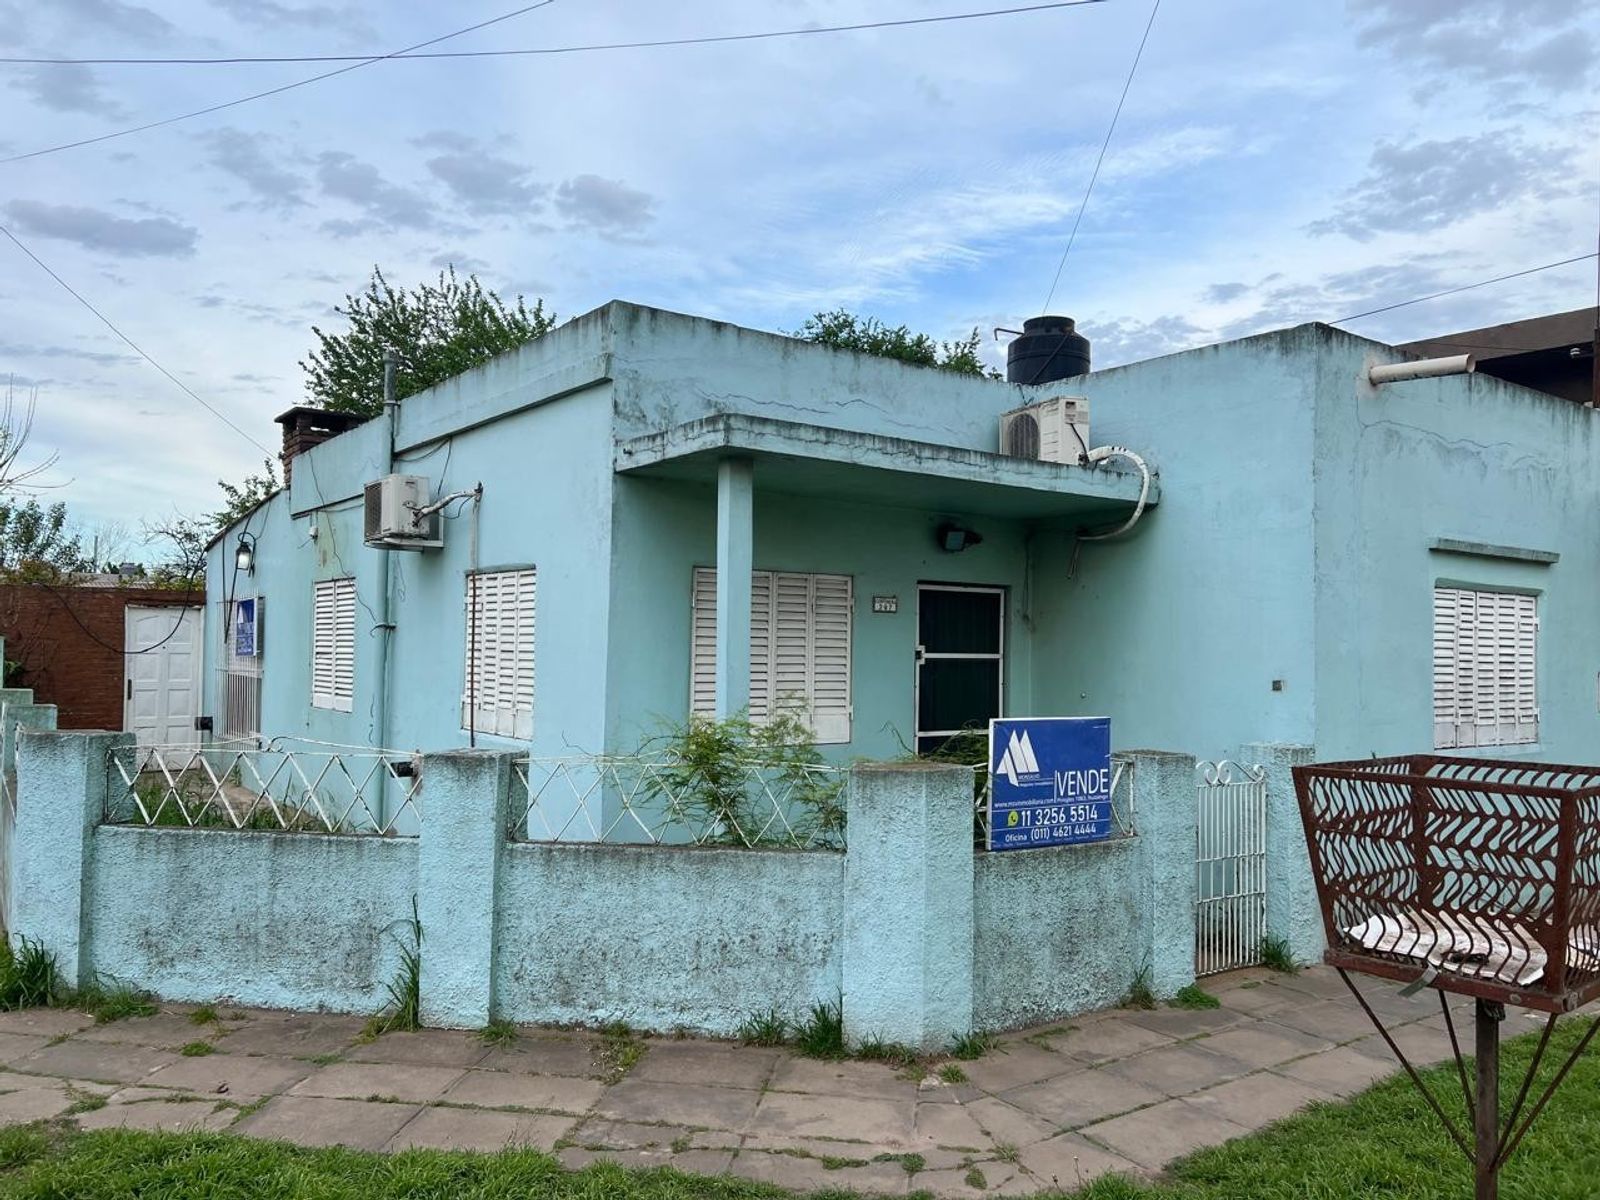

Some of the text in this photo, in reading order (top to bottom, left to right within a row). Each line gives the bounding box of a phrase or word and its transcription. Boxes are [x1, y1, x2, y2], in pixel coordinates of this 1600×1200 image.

[1057, 768, 1108, 797] VENDE
[1021, 805, 1098, 826] 11 3256 5514
[1005, 833, 1027, 843] Oficina
[1031, 827, 1050, 841] (011)
[1053, 825, 1072, 837] 4621
[1074, 823, 1096, 834] 4444
